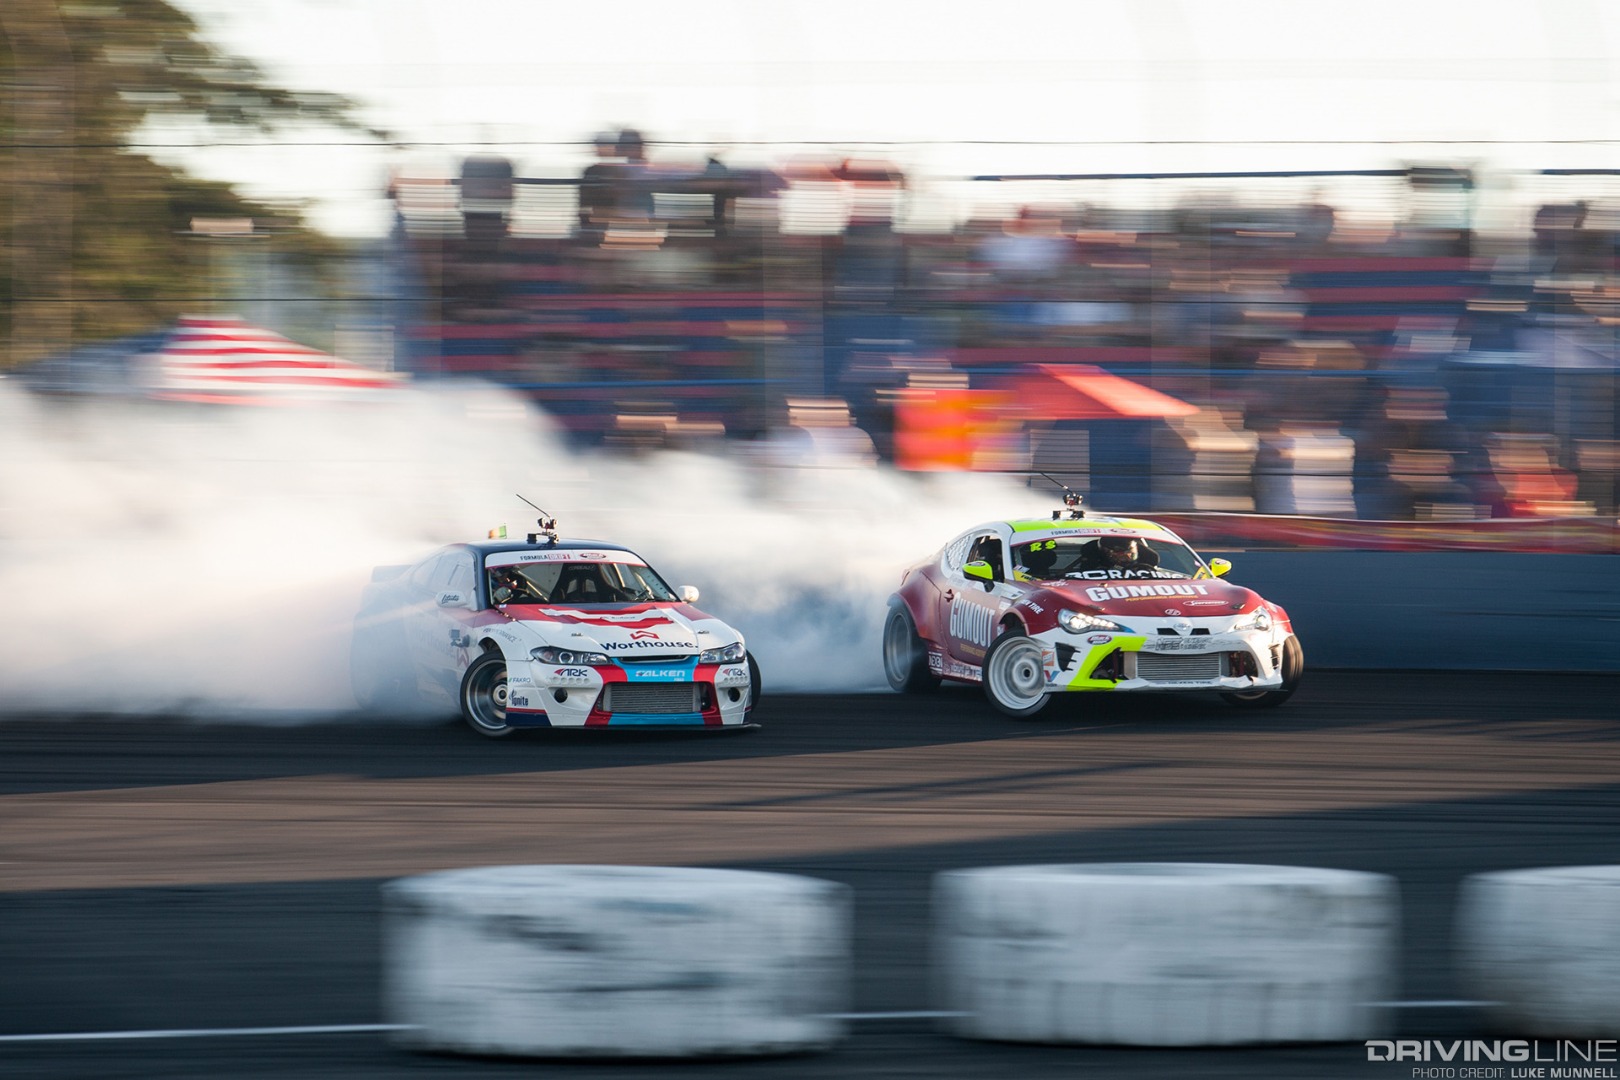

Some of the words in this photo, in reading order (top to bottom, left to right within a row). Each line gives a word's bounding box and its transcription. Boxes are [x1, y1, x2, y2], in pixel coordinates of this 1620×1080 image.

[1085, 584, 1208, 602] GUMOUT
[949, 592, 996, 648] GUMOUT
[600, 640, 699, 650] Worthouse.
[555, 668, 588, 677] ARK
